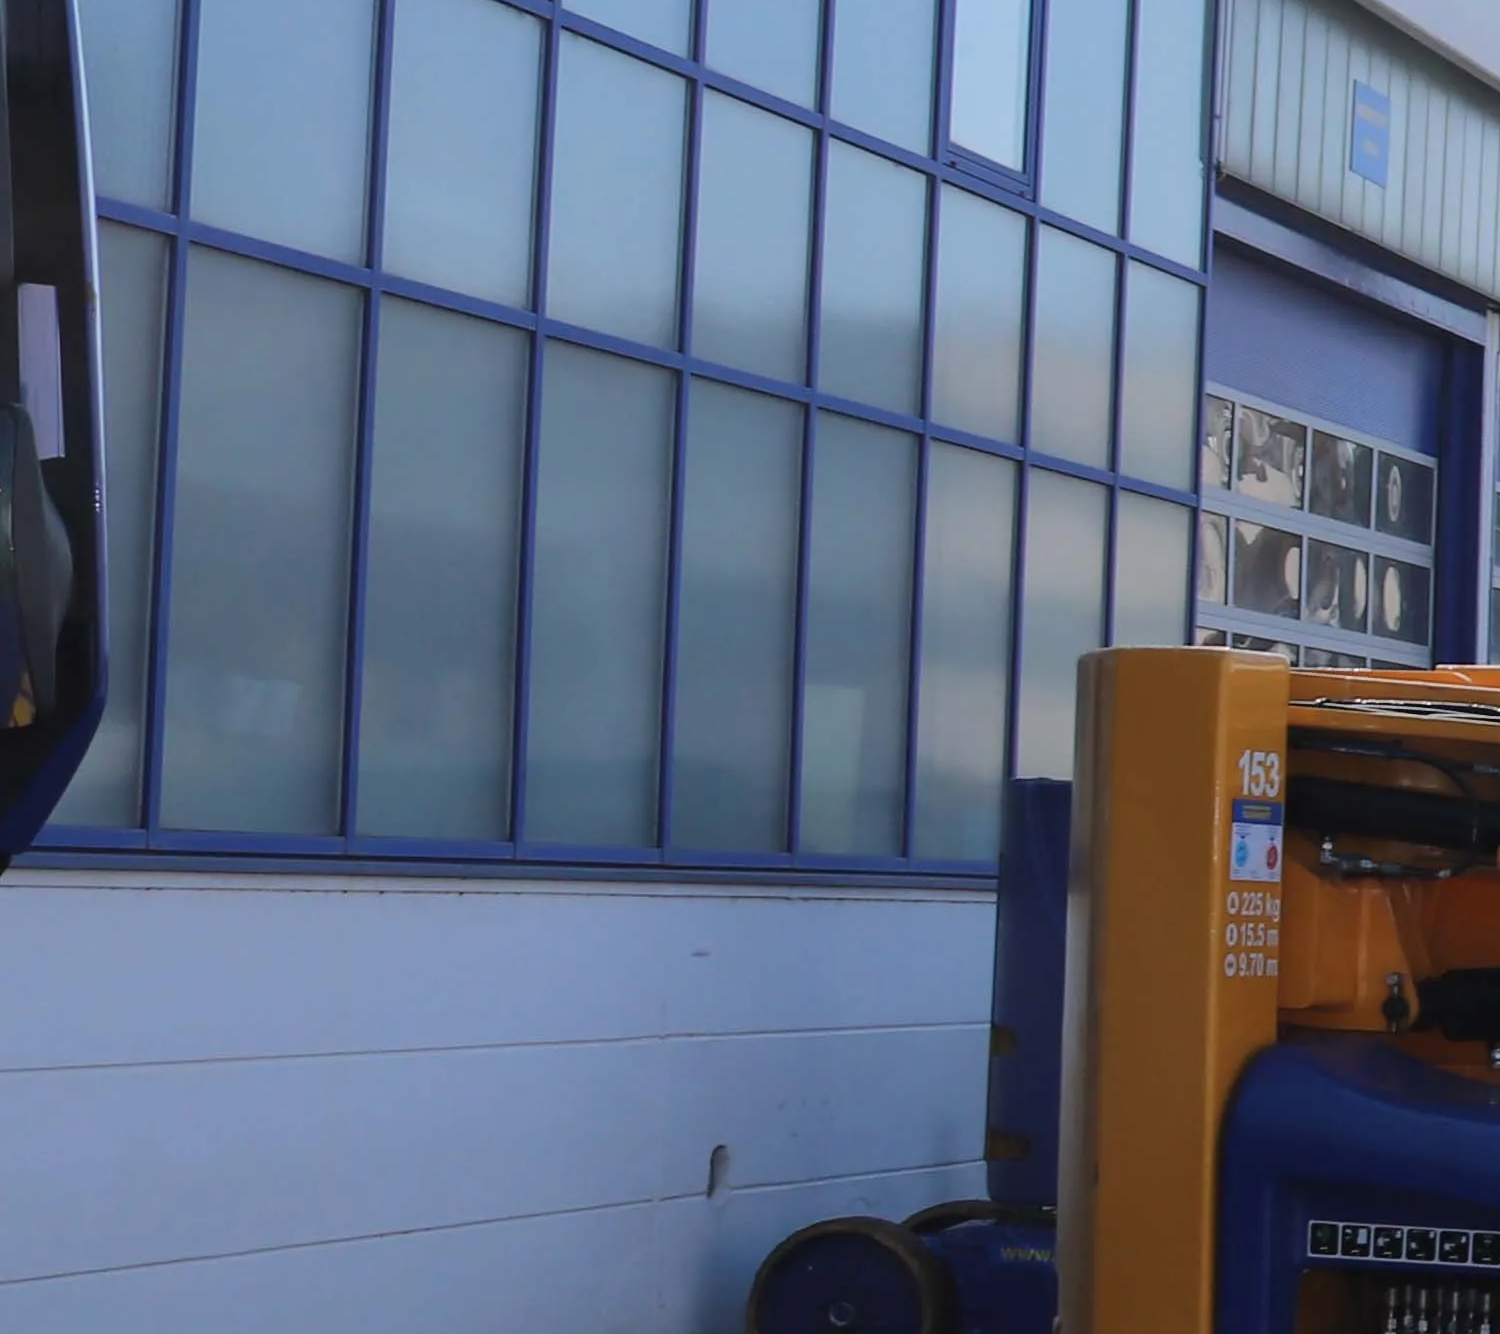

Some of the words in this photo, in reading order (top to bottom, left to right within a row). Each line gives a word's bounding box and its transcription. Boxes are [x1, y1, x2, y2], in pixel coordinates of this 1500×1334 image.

[1238, 748, 1281, 798] 153
[1240, 892, 1264, 917] 225
[1265, 893, 1281, 923] kg
[1239, 922, 1265, 947] 15.5
[1266, 928, 1279, 947] m
[1238, 952, 1265, 978] 9.70
[1266, 958, 1279, 977] m
